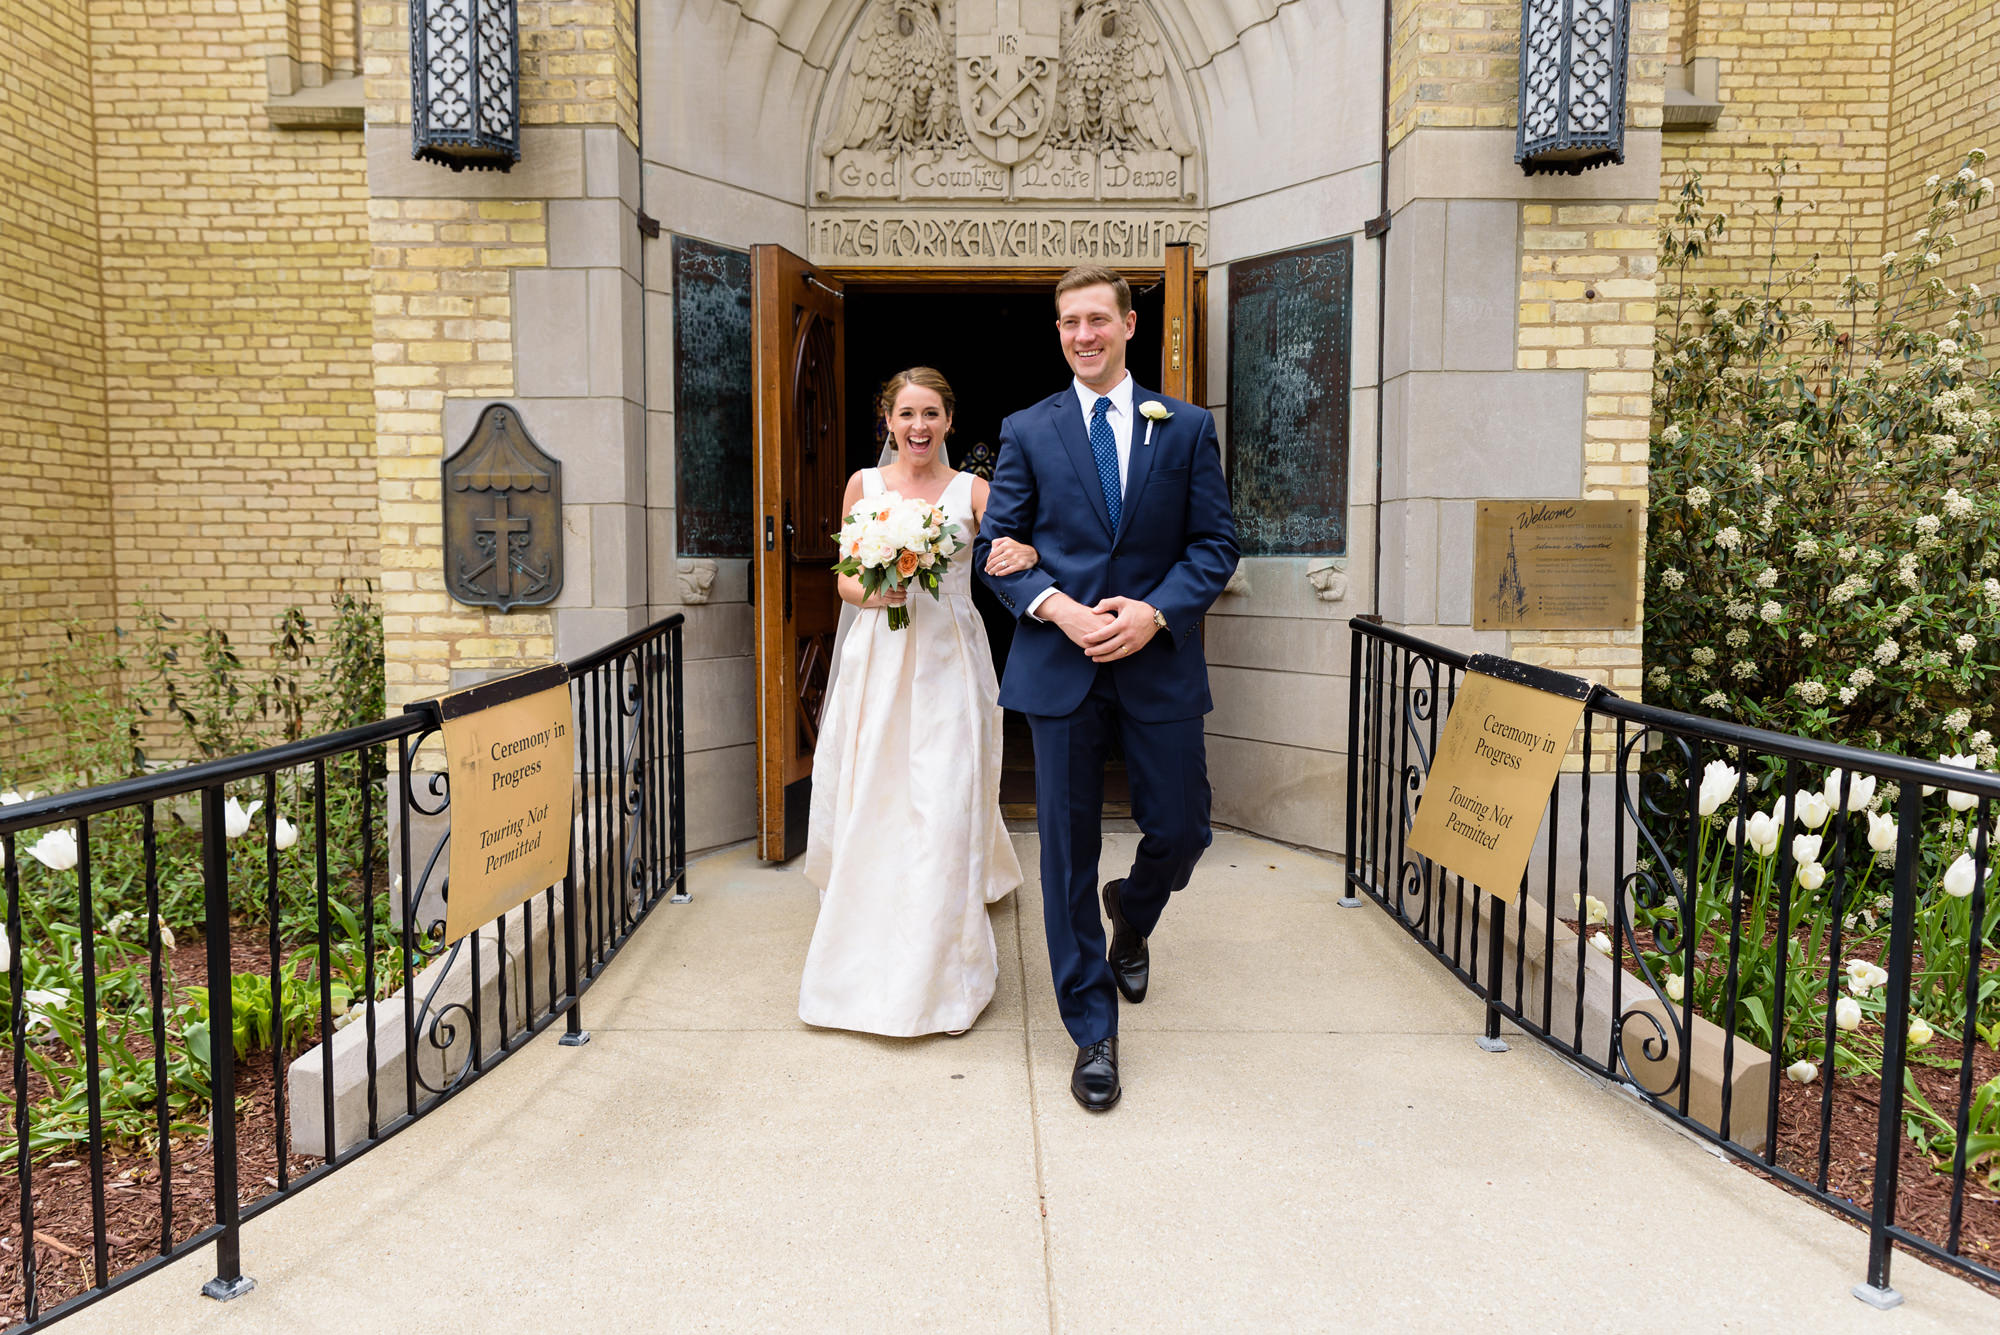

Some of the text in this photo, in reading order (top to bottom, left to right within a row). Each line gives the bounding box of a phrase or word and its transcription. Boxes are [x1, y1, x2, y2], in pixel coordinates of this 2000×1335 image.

[839, 160, 1177, 192] God Country Notre Dame
[1516, 504, 1576, 530] Welcome
[491, 722, 565, 761] Ceremony in
[1483, 714, 1556, 754] Ceremony in
[1474, 737, 1523, 770] Progress
[491, 759, 542, 791] Progress
[1449, 786, 1513, 829] Touring Not
[479, 804, 549, 850] Touring Not
[1446, 813, 1500, 850] Permitted
[484, 831, 542, 875] Permitted
